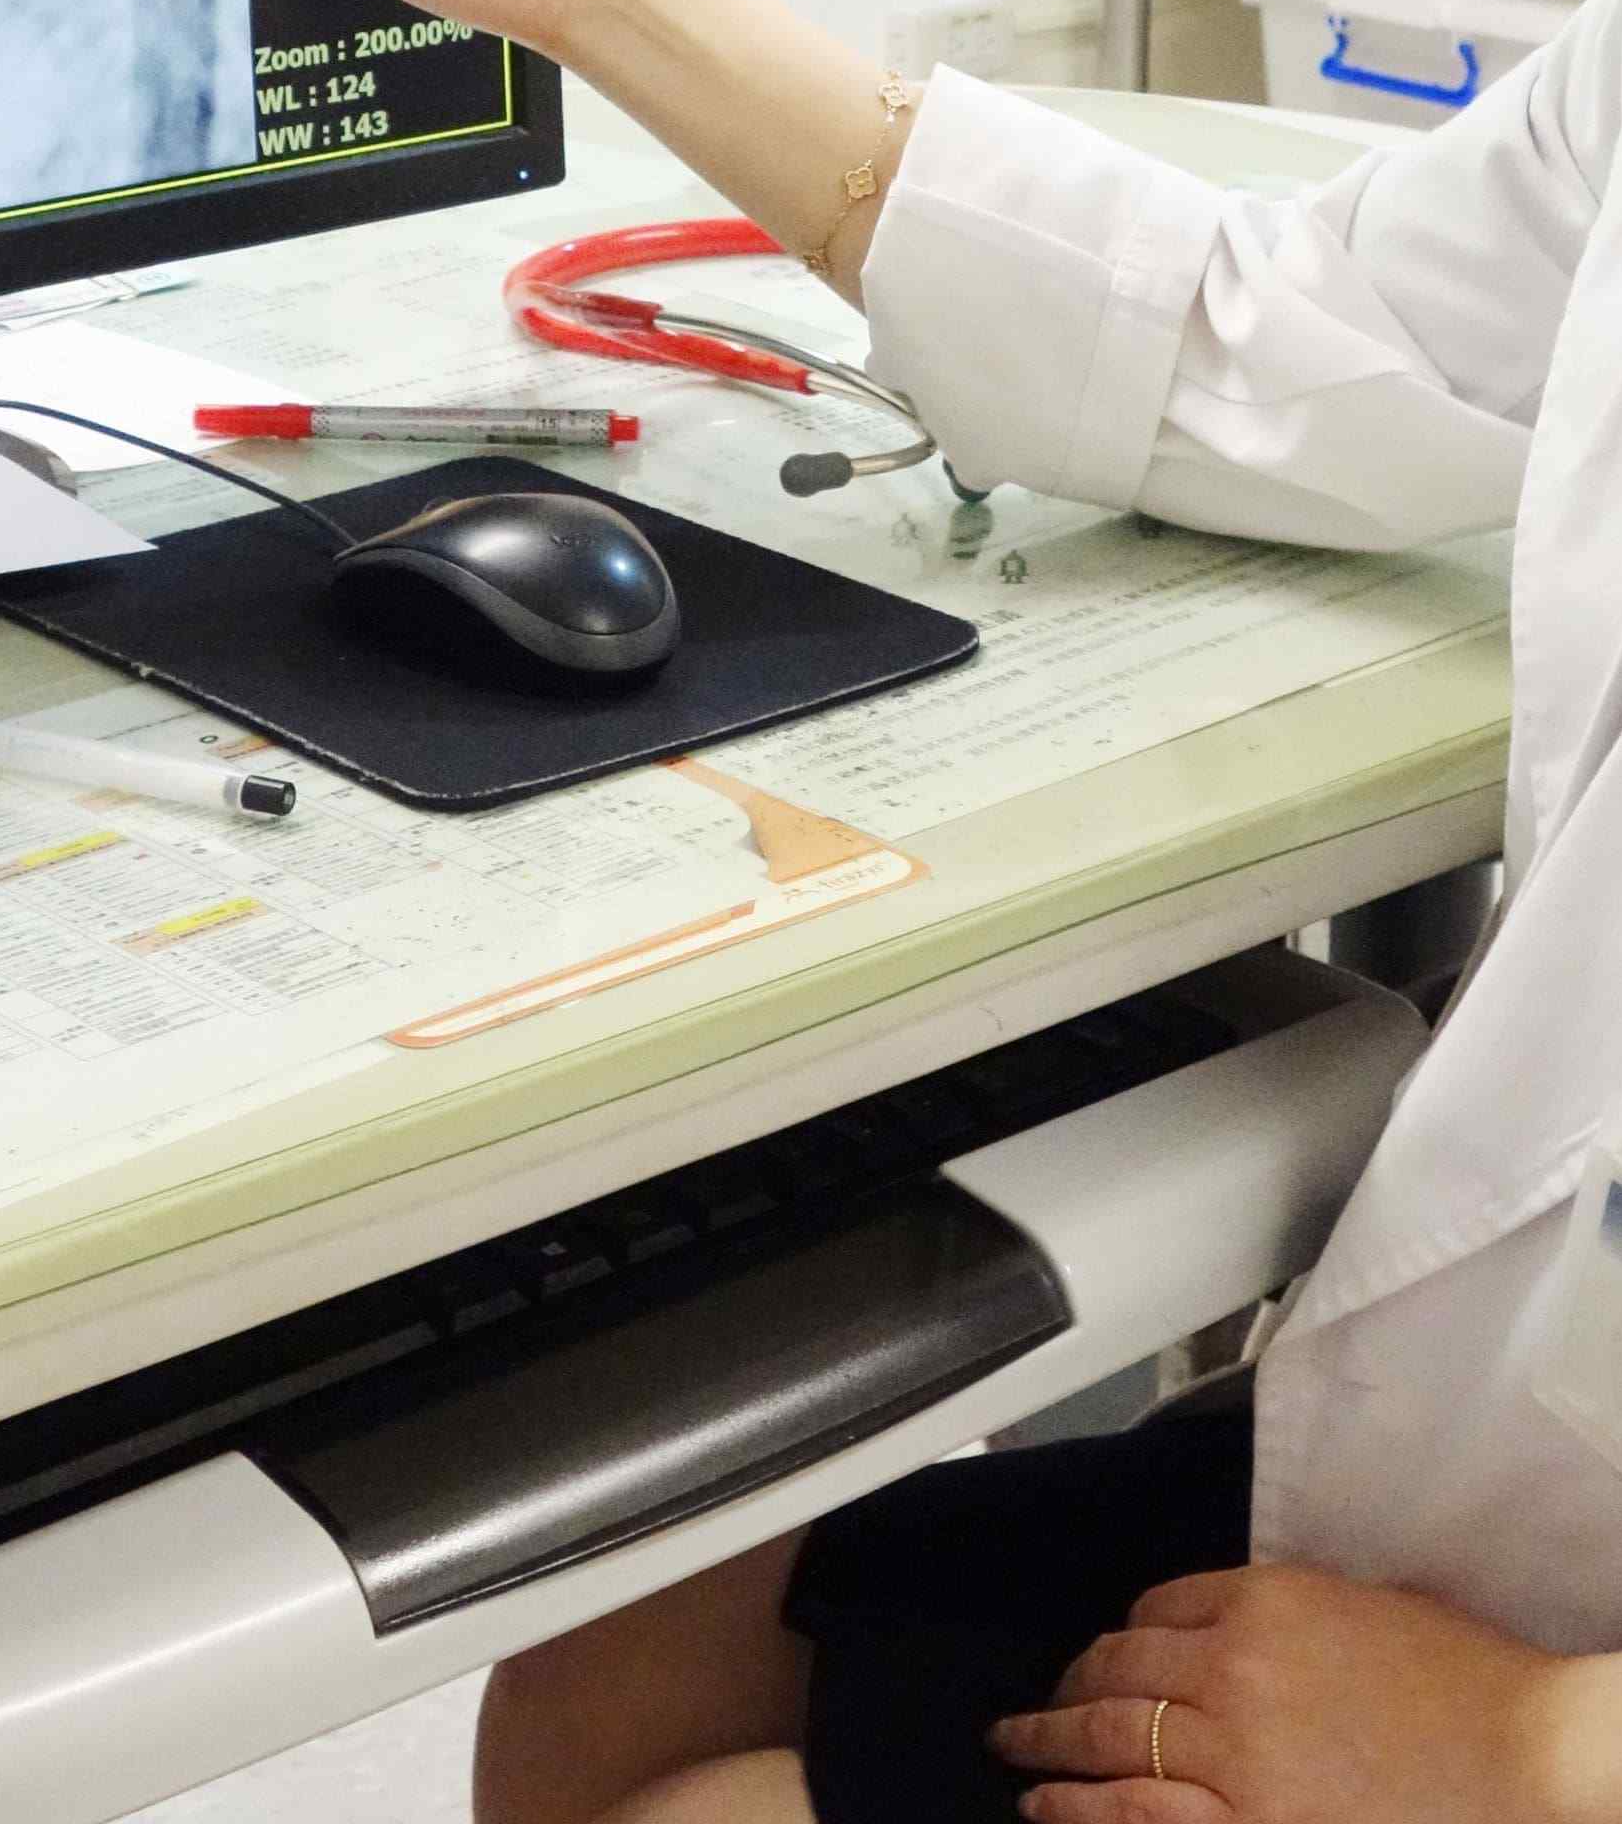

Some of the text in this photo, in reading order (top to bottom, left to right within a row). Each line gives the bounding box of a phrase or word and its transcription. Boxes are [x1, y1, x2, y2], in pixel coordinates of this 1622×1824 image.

[254, 42, 329, 75] Zoom
[353, 20, 473, 59] 200.00%
[256, 85, 302, 115] WL
[326, 71, 377, 104] 124
[258, 122, 316, 157] WW
[339, 110, 390, 142] 143
